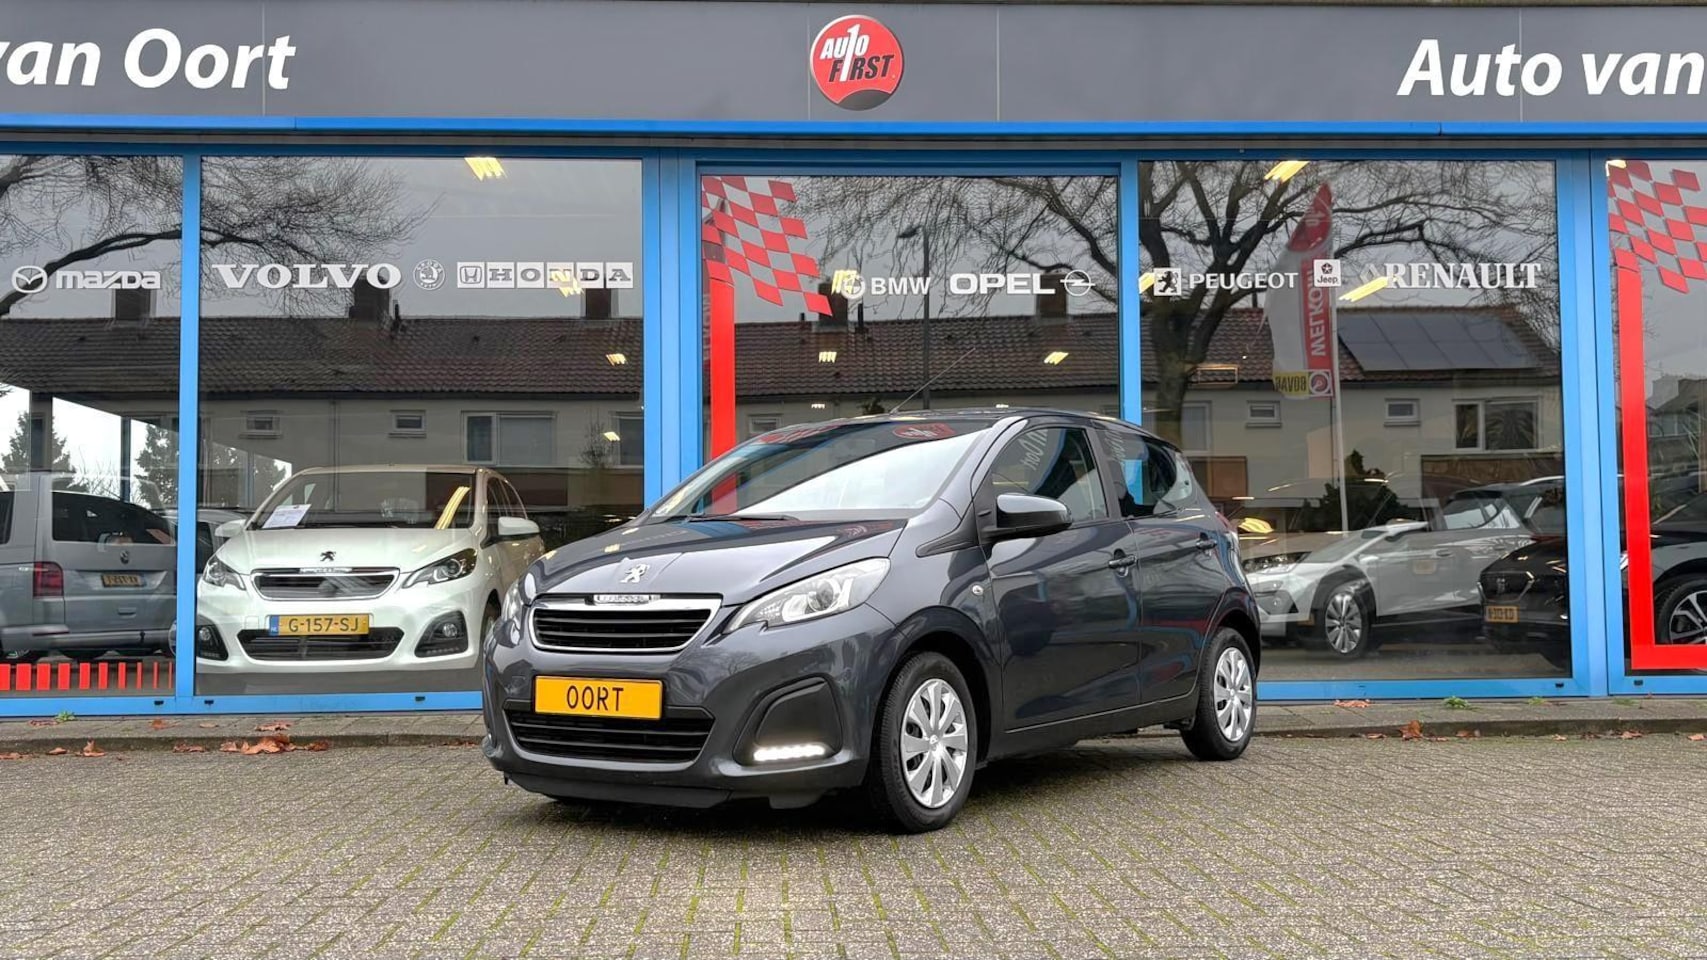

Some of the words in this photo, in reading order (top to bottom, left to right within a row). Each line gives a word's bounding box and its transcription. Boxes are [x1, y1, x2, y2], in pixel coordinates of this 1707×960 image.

[0, 41, 101, 86] an
[124, 28, 296, 89] Oort
[828, 54, 895, 82] FIRST
[1396, 39, 1562, 96] Auto
[1582, 52, 1705, 96] van
[211, 263, 402, 289] VOLVO
[488, 266, 632, 283] HONDA
[871, 277, 931, 295] BMW
[950, 273, 1055, 295] OPEL
[1189, 272, 1299, 290] PEUGEOT
[1316, 275, 1339, 285] Jeep
[1384, 262, 1541, 289] RENAULT
[288, 618, 359, 632] G-157-SJ
[566, 685, 624, 711] OORT
